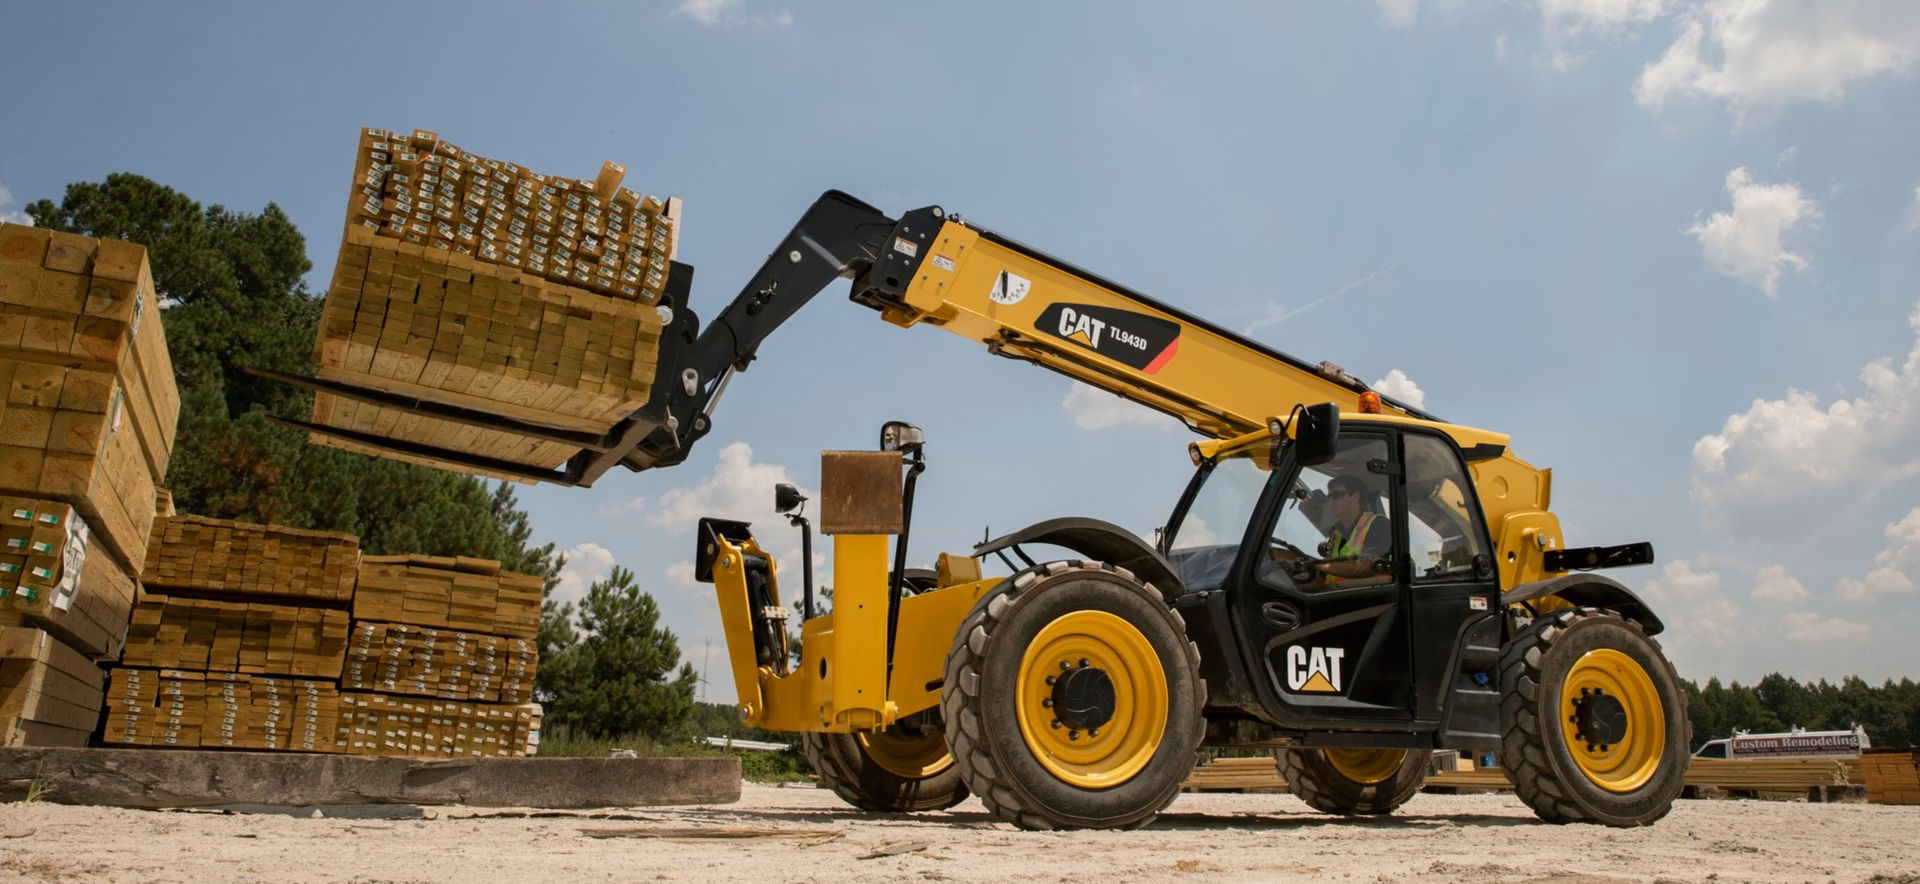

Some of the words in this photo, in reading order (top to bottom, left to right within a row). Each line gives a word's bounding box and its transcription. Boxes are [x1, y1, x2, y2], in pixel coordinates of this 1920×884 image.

[1058, 307, 1106, 349] CAT
[1110, 326, 1148, 351] TL943D
[1287, 645, 1345, 692] CAT
[1733, 739, 1778, 749] Custom
[1782, 735, 1858, 747] Remodeling
